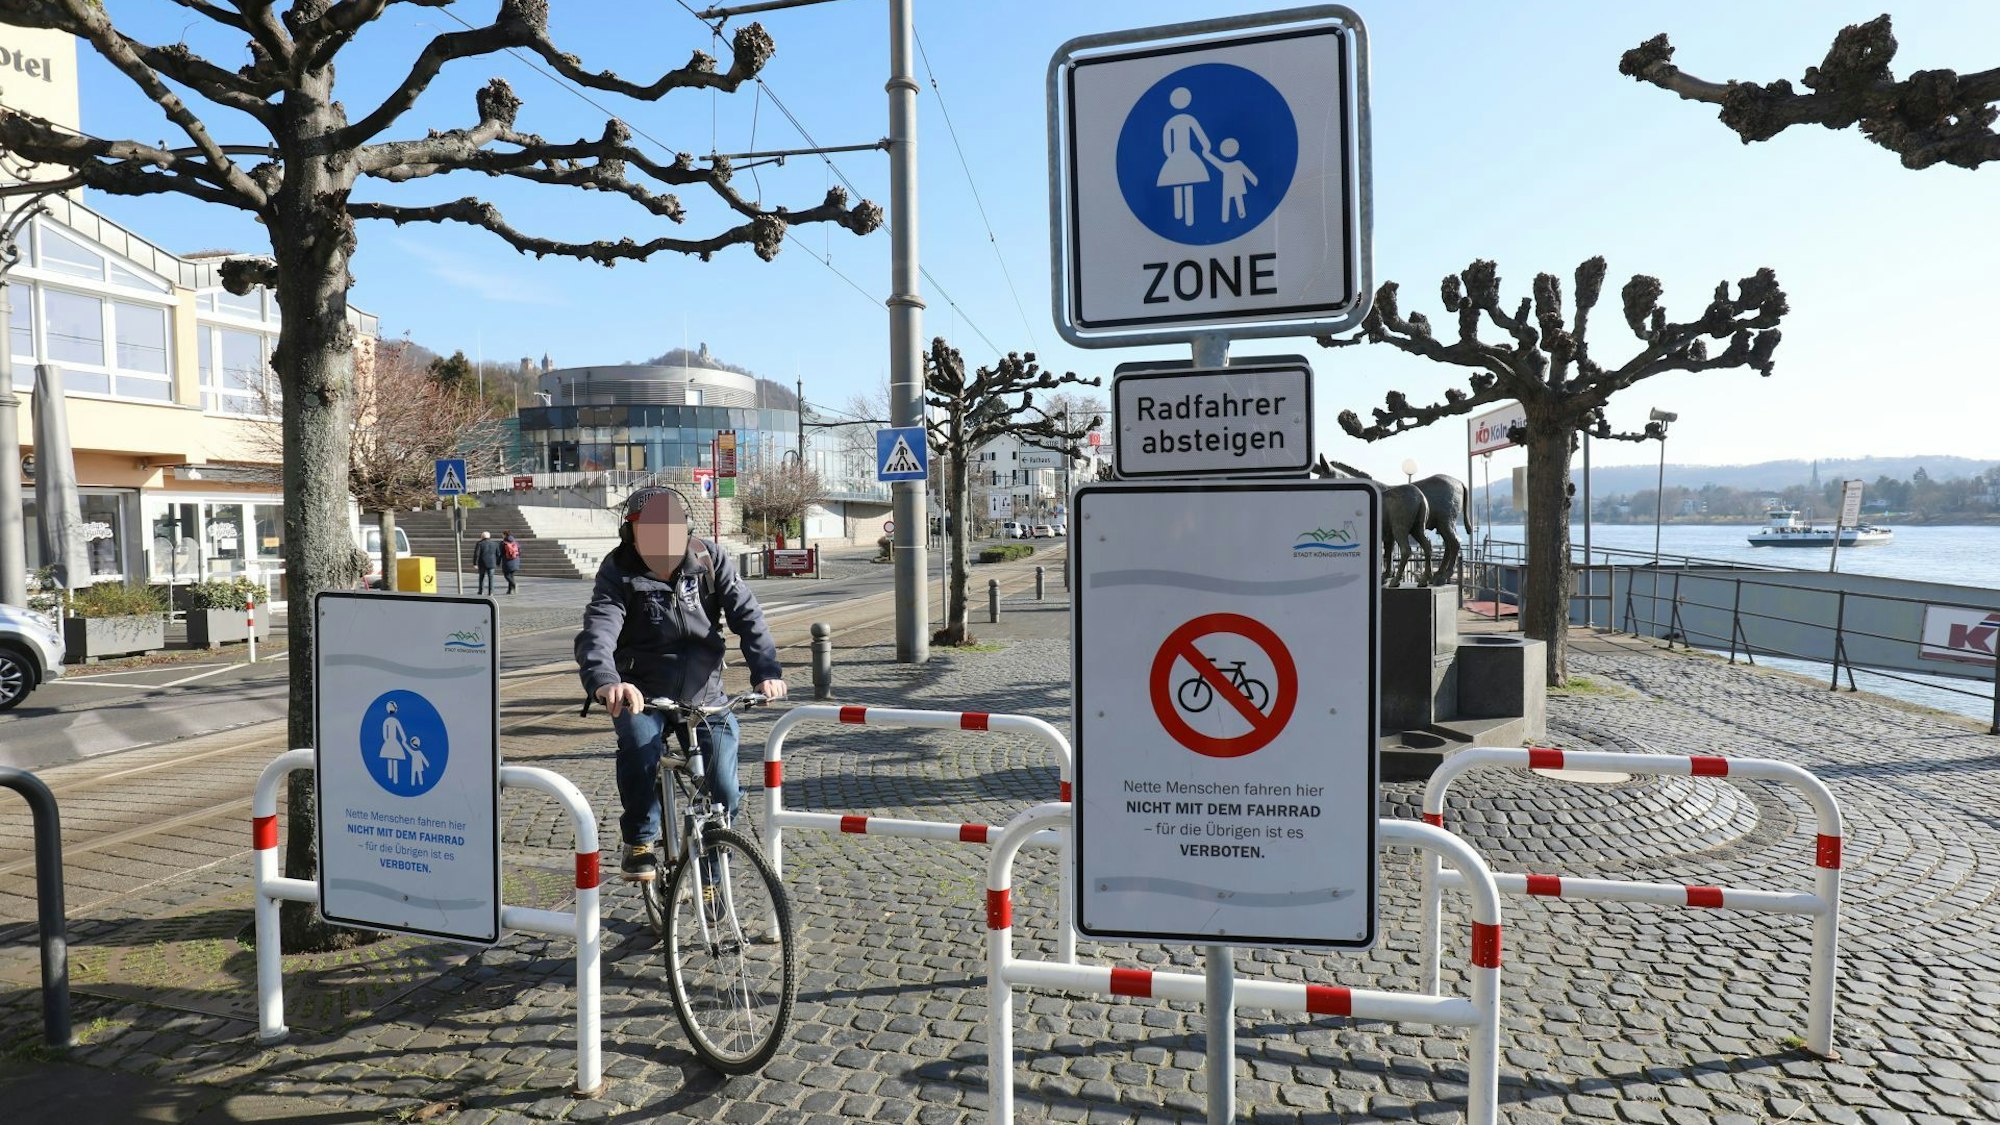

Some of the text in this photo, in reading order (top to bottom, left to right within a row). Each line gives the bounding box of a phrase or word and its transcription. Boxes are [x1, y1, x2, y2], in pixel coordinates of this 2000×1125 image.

[1142, 252, 1278, 305] ZONE
[1137, 393, 1287, 421] Radfahrer
[1142, 427, 1285, 460] absteigen
[1313, 550, 1361, 558] KÖNIGSWINTER
[1124, 780, 1325, 797] Nette Menschen fahren hier
[345, 807, 467, 831] Nette Menschen fahren hier
[1126, 801, 1321, 818] NICHT MIT DEM FAHRRAD
[347, 824, 465, 846] NICHT MIT DEM FAHRRAD
[1156, 822, 1176, 836] für
[1180, 822, 1201, 836] die
[1206, 820, 1261, 840] Übrigen
[1266, 825, 1283, 838] ist
[1287, 827, 1304, 839] es
[365, 841, 378, 852] für
[380, 842, 393, 853] die
[395, 842, 429, 859] Übrigen
[430, 848, 442, 860] ist
[444, 851, 455, 861] es
[1179, 843, 1266, 859] VERBOTEN.
[379, 858, 432, 874] VERBOTEN.
